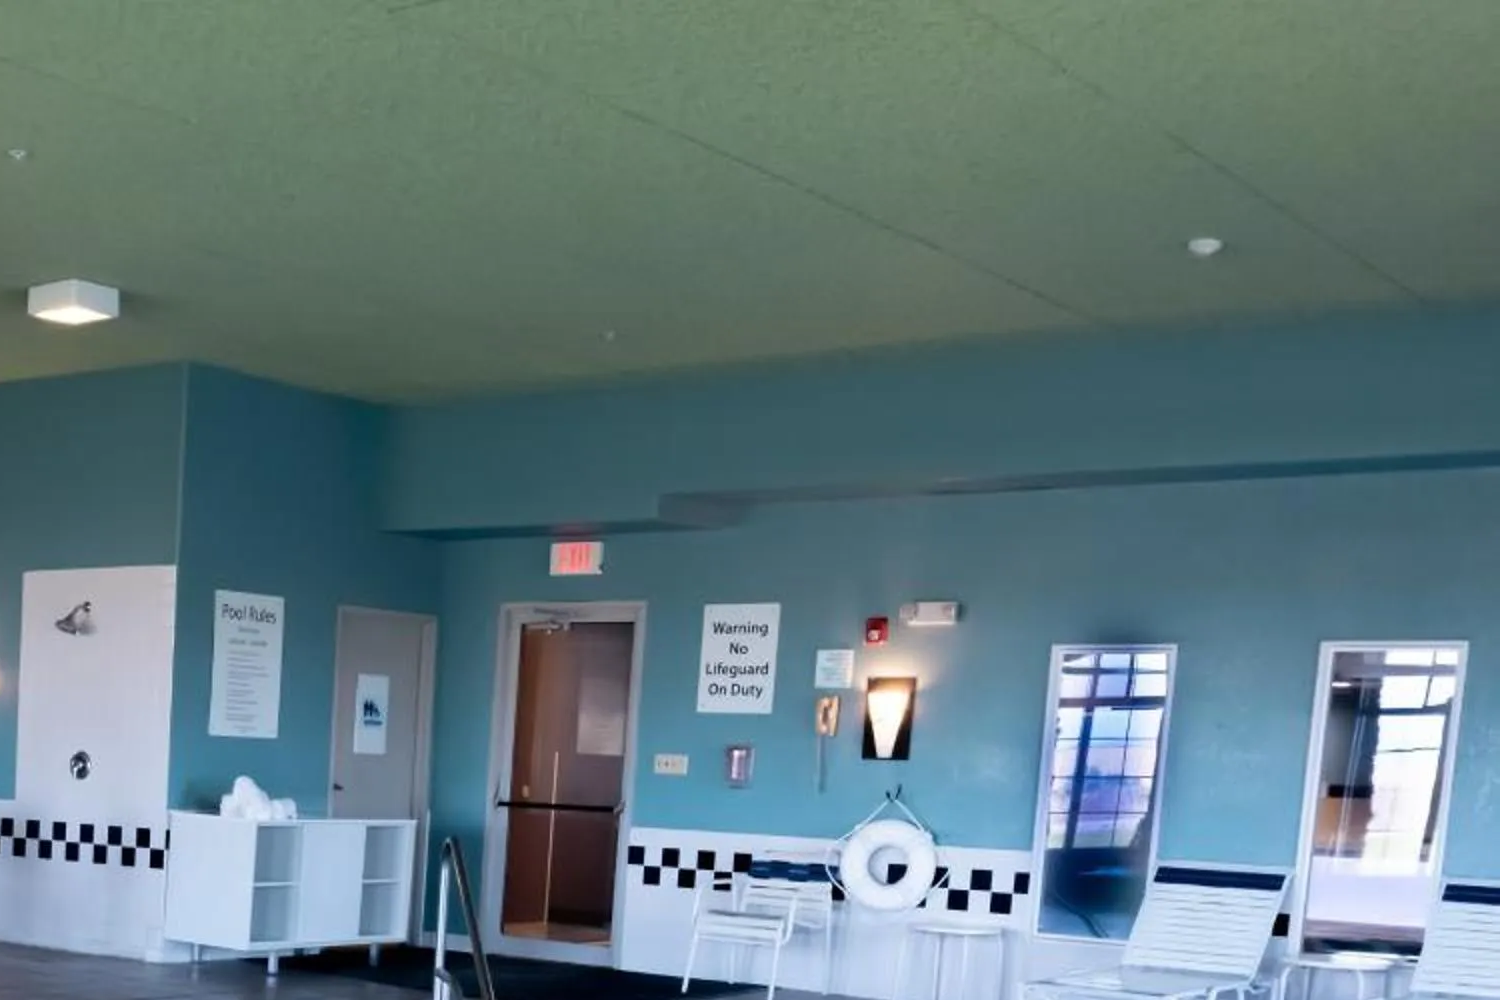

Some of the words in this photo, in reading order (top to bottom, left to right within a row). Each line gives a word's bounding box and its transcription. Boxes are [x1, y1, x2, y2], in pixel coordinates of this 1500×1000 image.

[221, 603, 247, 621] Pool
[249, 605, 277, 625] Rules
[713, 621, 769, 637] Warning
[729, 642, 749, 655] No
[705, 662, 769, 678] Lifeguard
[708, 683, 727, 696] On
[731, 683, 763, 699] Duty
